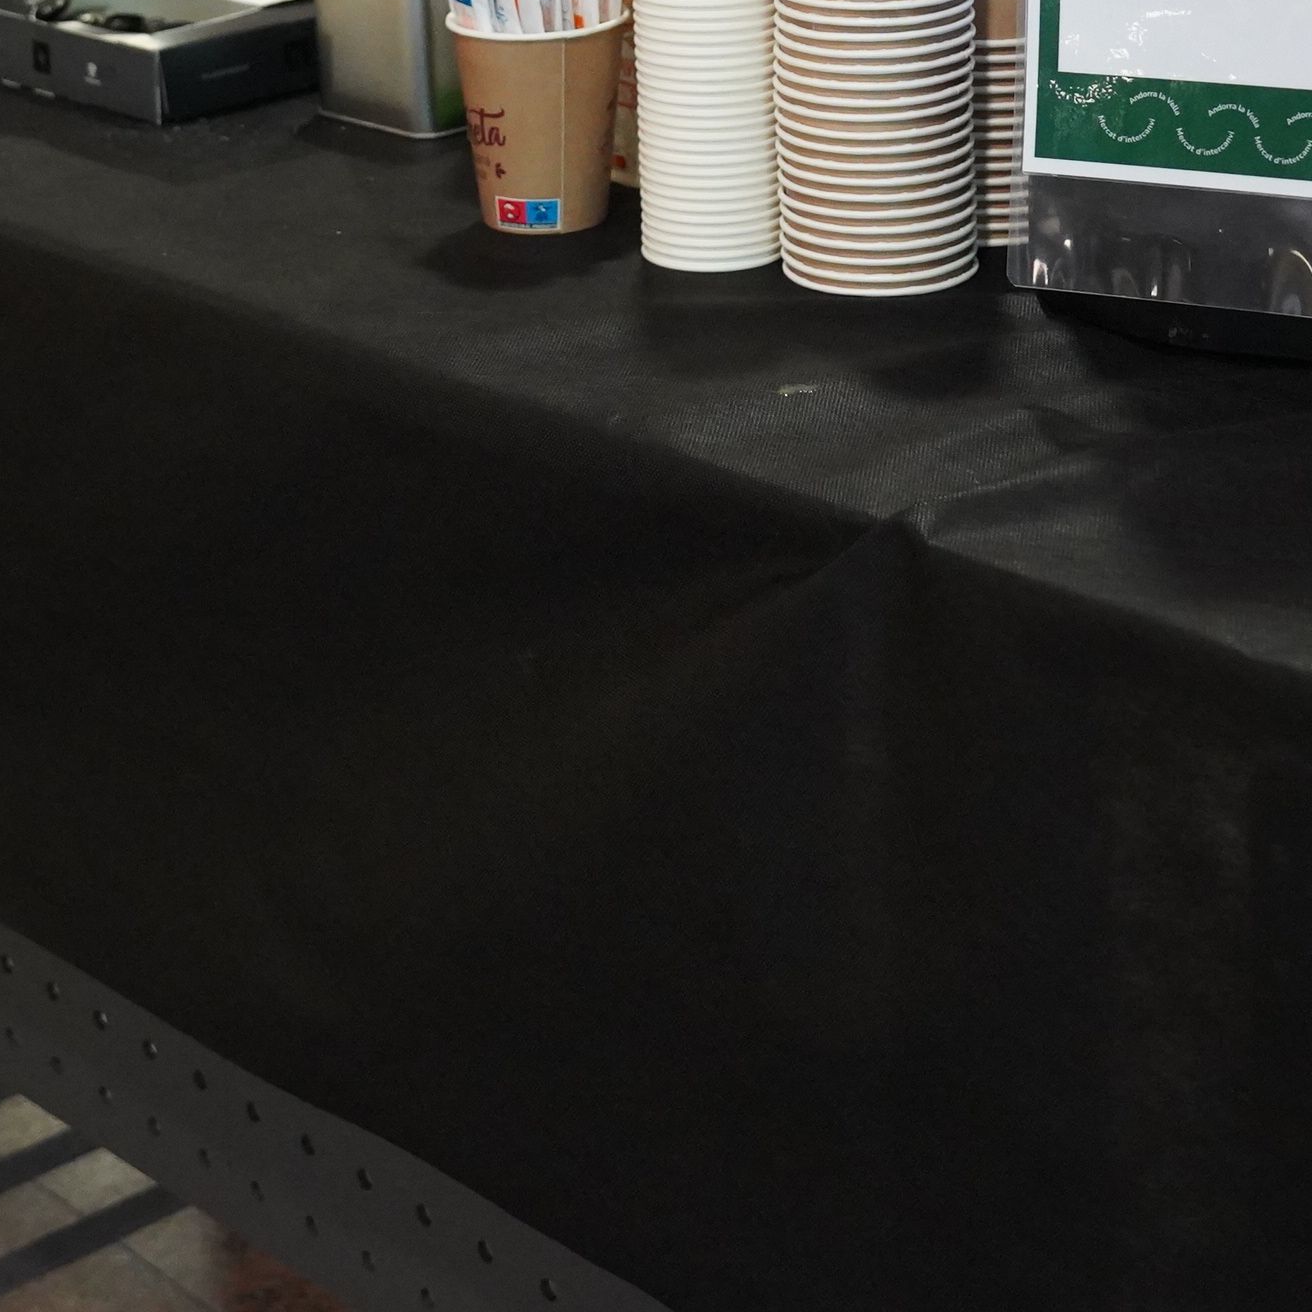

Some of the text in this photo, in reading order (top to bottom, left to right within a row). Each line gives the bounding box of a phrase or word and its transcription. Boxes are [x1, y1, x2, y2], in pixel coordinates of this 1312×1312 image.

[1129, 91, 1181, 117] Andorra la Vella
[1208, 103, 1260, 129] Andorra la Vella
[1097, 114, 1117, 140] Mercat
[1175, 127, 1196, 153] Mercat
[1254, 135, 1274, 161] Mercat
